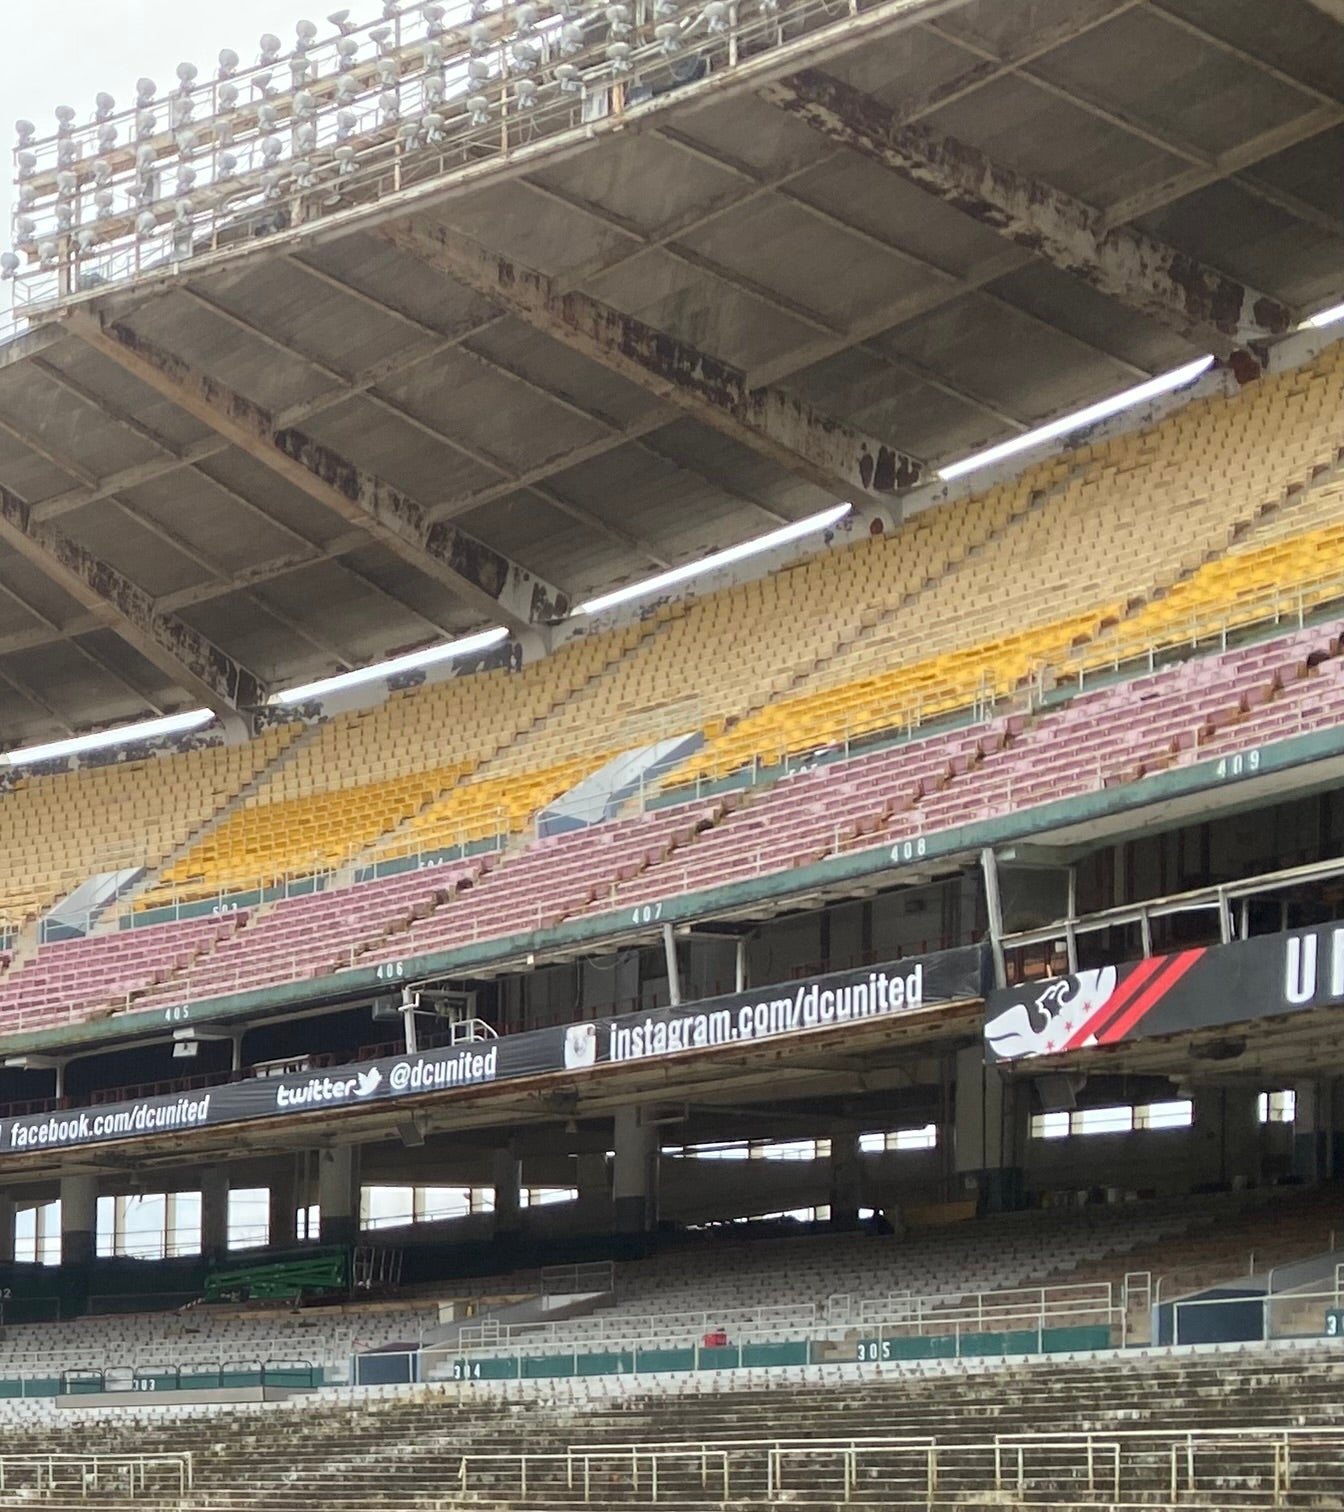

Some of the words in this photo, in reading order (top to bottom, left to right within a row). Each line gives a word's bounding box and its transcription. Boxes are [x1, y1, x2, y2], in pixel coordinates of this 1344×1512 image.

[1217, 751, 1260, 779] 409
[890, 838, 926, 862] 408
[632, 902, 663, 924] 407
[377, 961, 404, 979] 406
[1285, 929, 1344, 1004] U
[165, 1005, 189, 1020] 405
[610, 964, 924, 1062] instagram.com/dcunited
[276, 1078, 357, 1107] twitter
[389, 1045, 497, 1091] @dcunited
[10, 1095, 210, 1148] facebook.com/dcunited
[1327, 1316, 1344, 1335] 3
[857, 1342, 891, 1360] 305
[453, 1363, 482, 1380] 304
